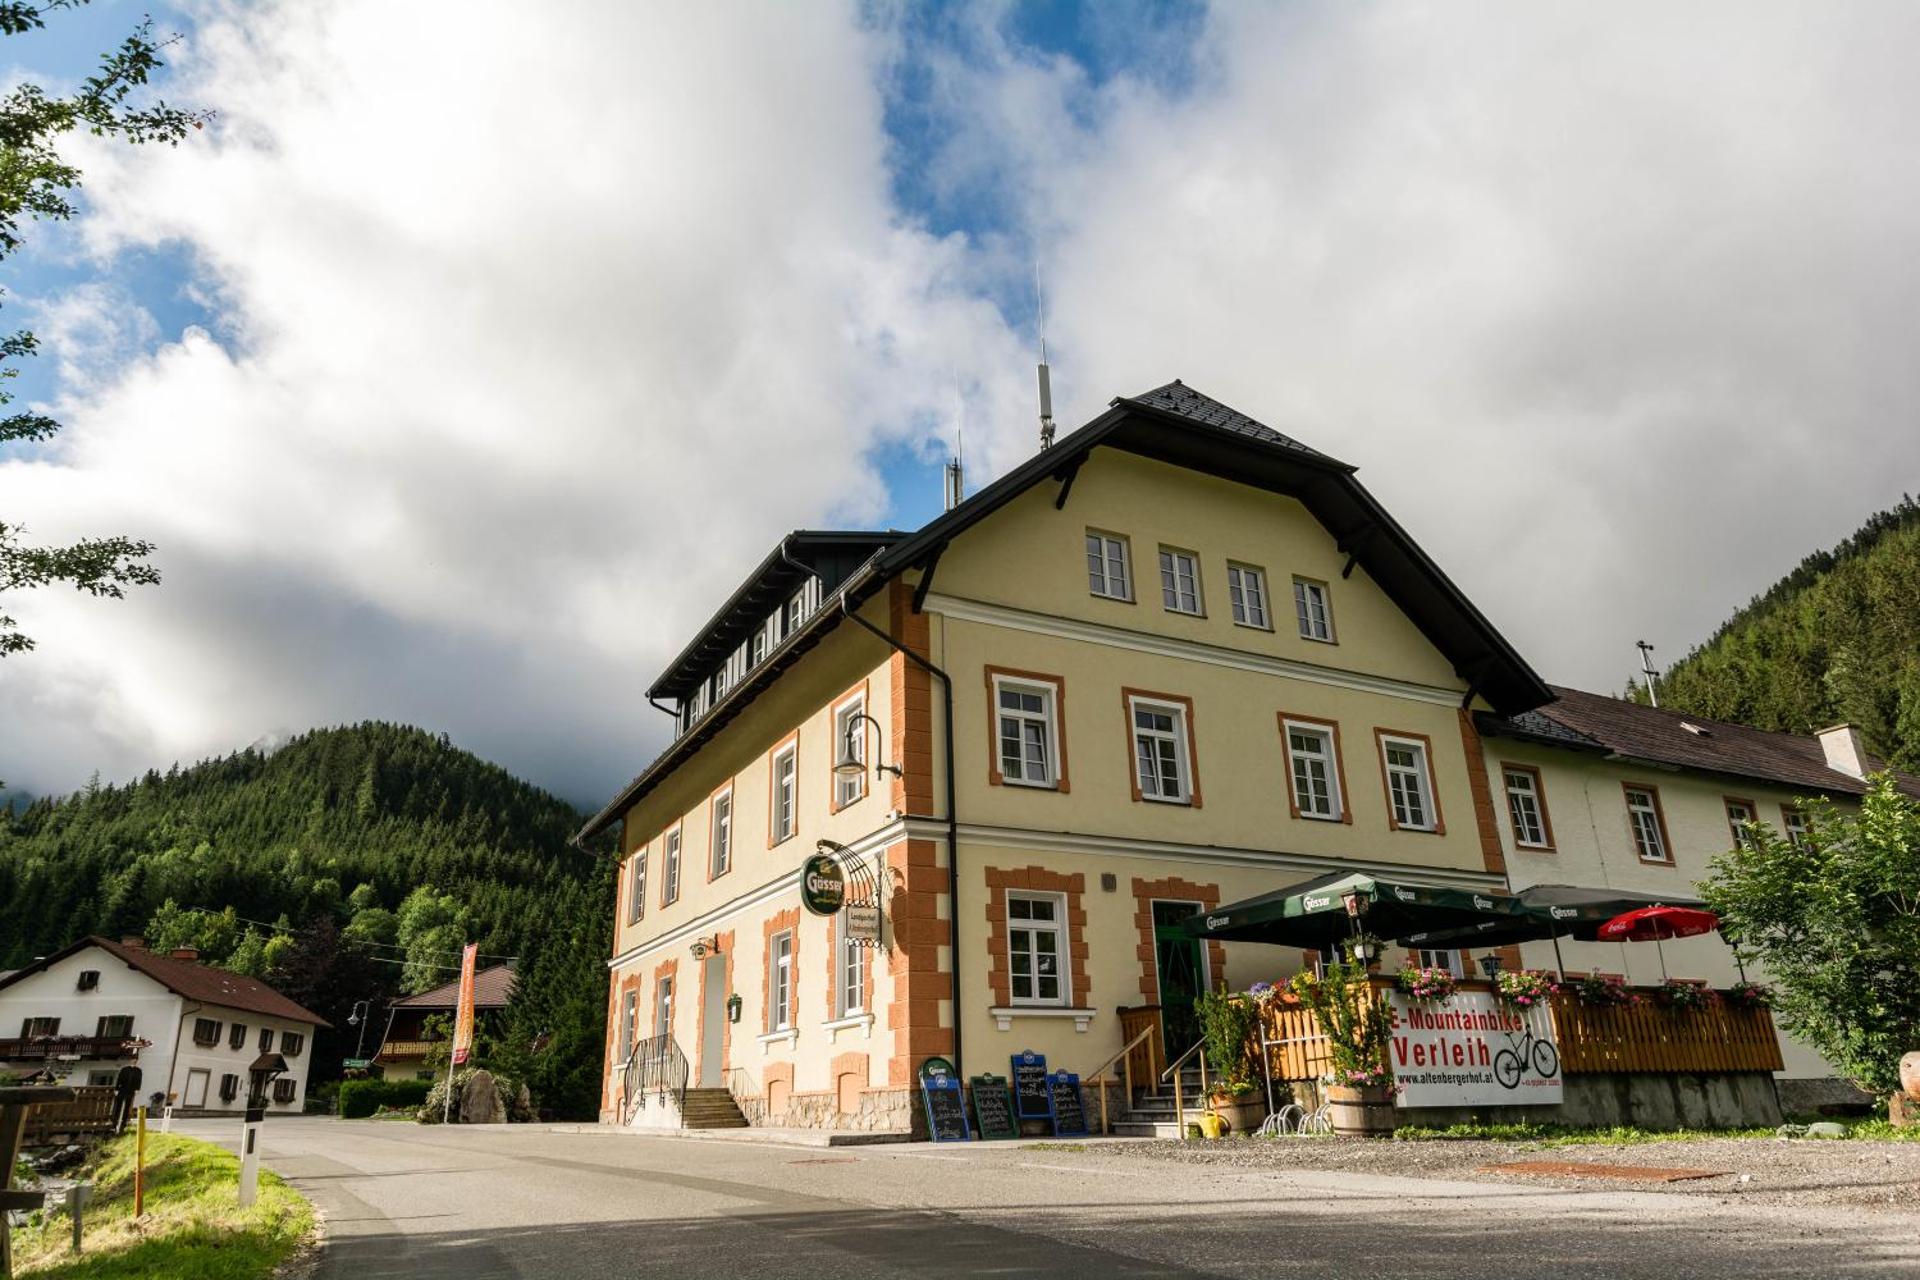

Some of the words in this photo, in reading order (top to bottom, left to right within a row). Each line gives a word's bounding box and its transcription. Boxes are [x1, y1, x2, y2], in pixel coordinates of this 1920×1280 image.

[807, 872, 843, 894] Gösser
[1391, 1007, 1523, 1032] E-Mountainbike
[1393, 1036, 1491, 1067] Verleih
[1398, 1071, 1494, 1086] www.altenbergerhof.at
